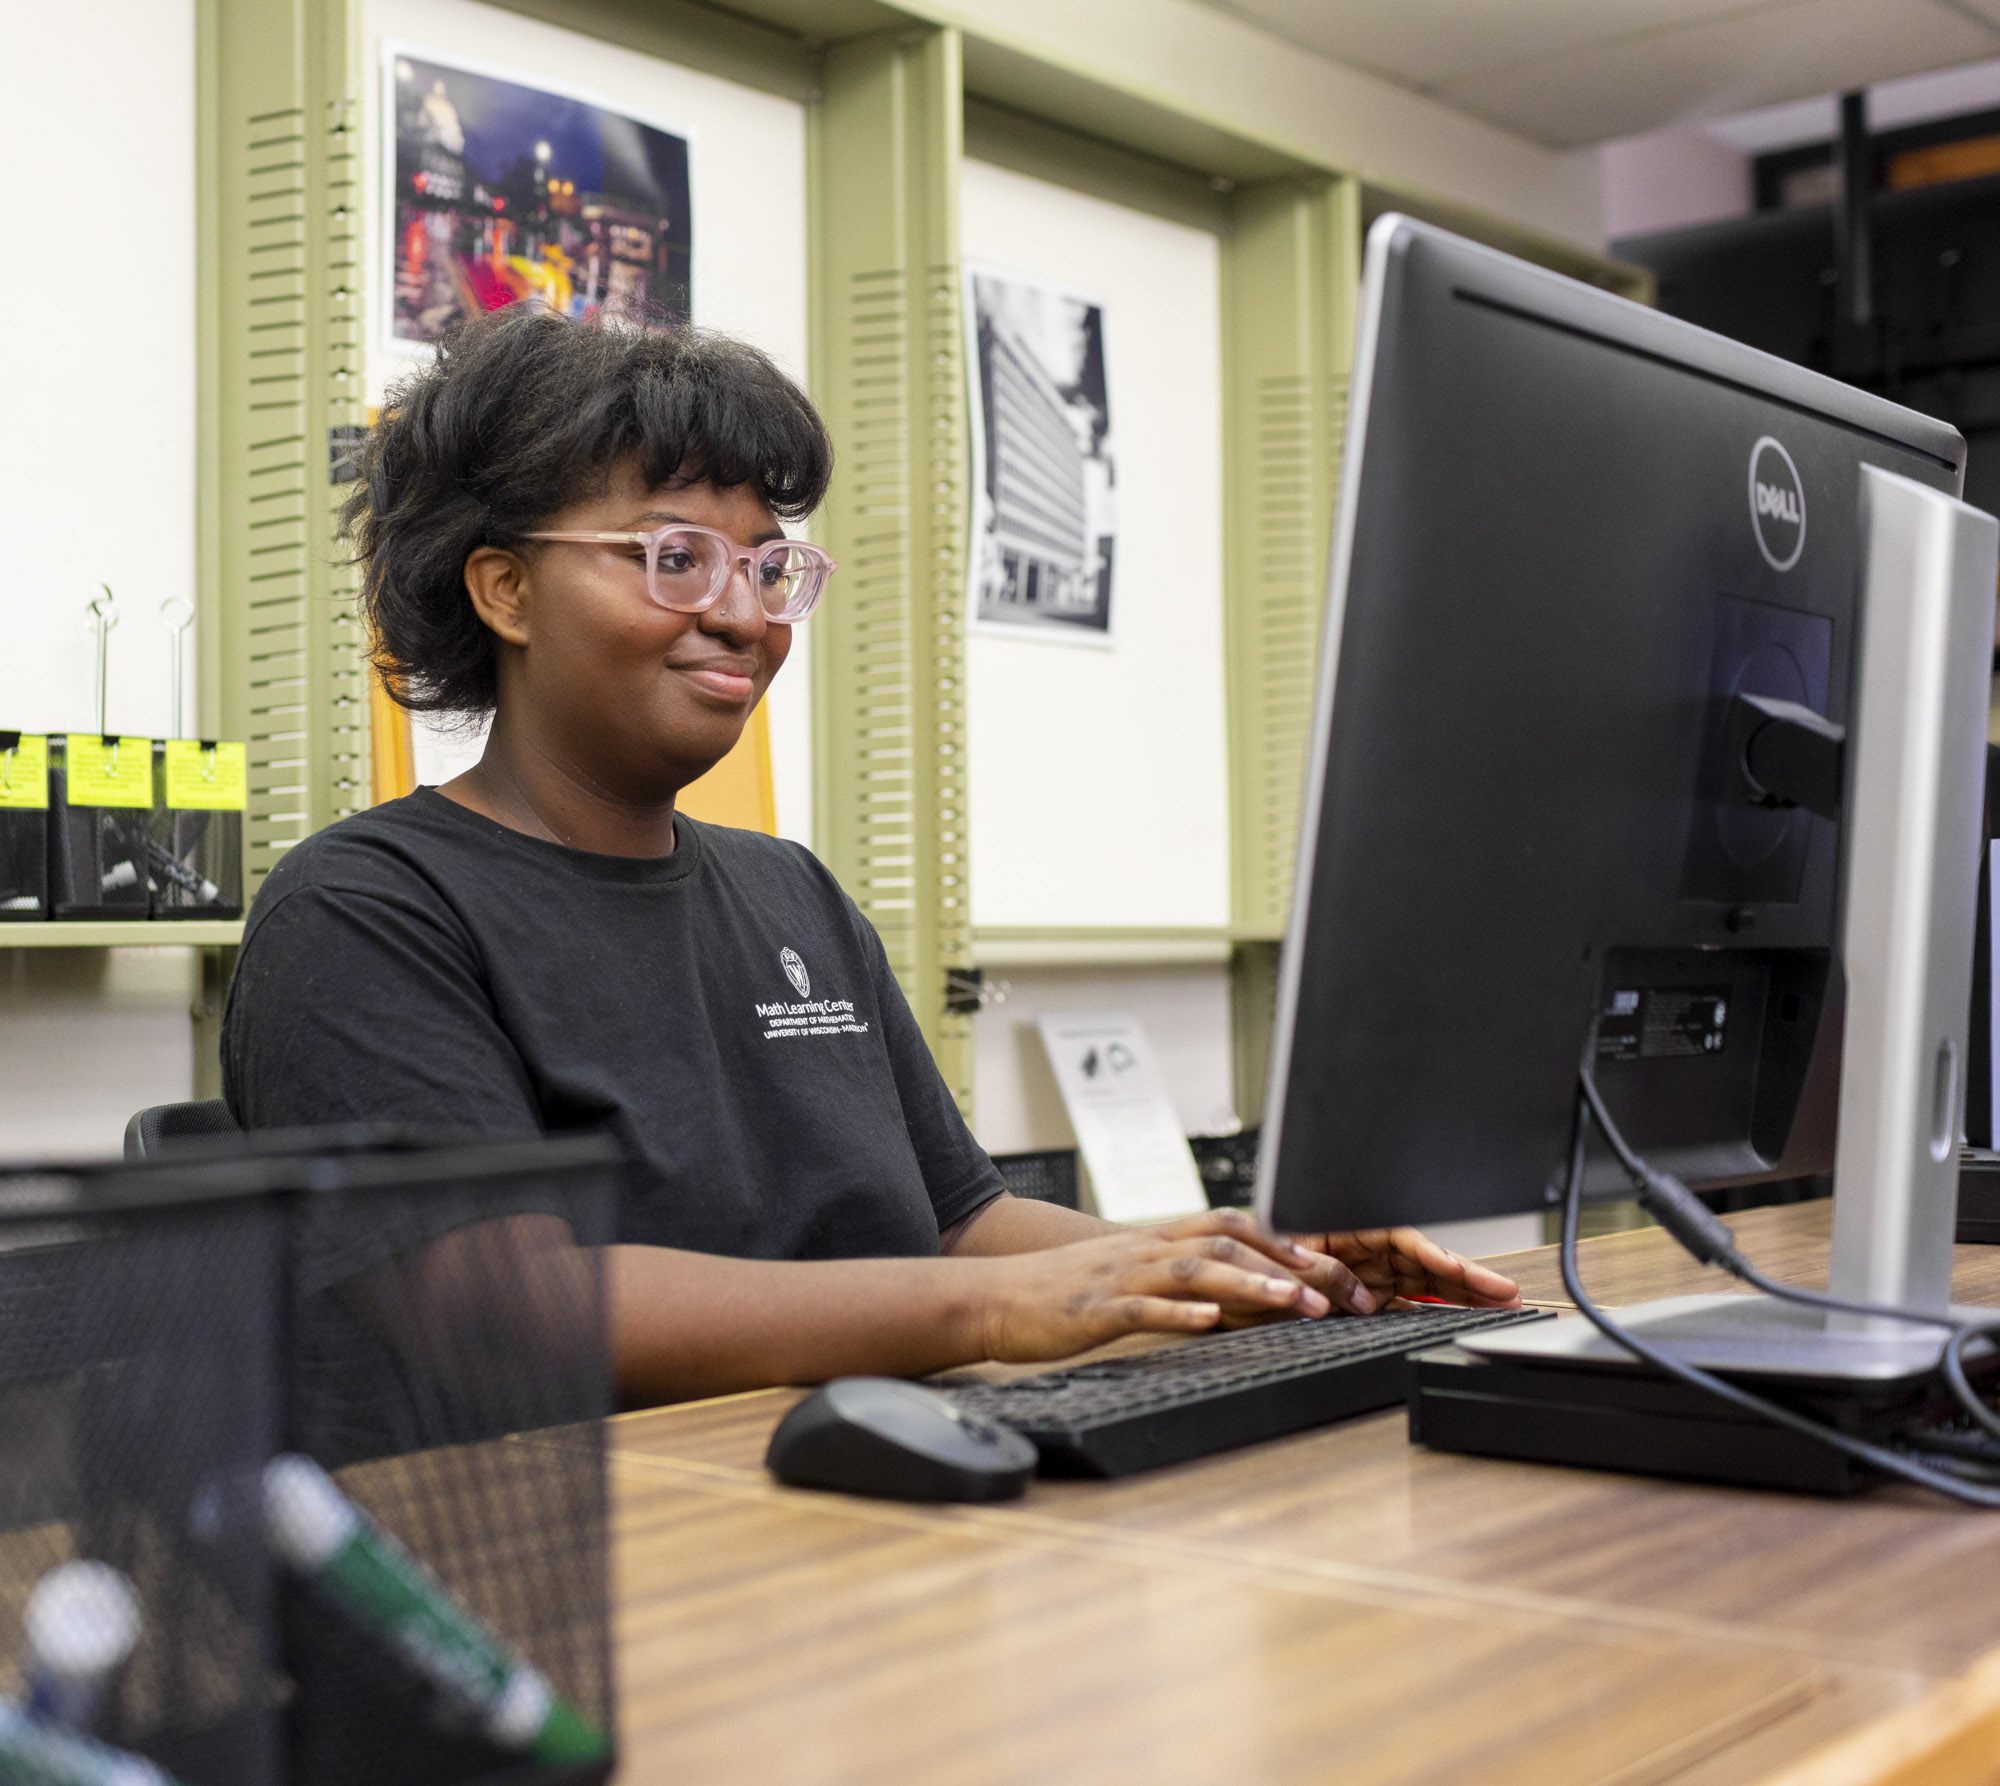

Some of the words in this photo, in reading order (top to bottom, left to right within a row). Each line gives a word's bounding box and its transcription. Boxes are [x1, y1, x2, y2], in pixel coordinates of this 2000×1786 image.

[1755, 481, 1800, 523] DELL
[755, 1002, 785, 1017] Math
[784, 1000, 825, 1015] Learning
[823, 999, 854, 1013] Center
[769, 1017, 809, 1028] DEPARTMENT
[809, 1016, 817, 1024] OF
[763, 1028, 801, 1040] UNIVERSITY
[801, 1028, 809, 1036] OF
